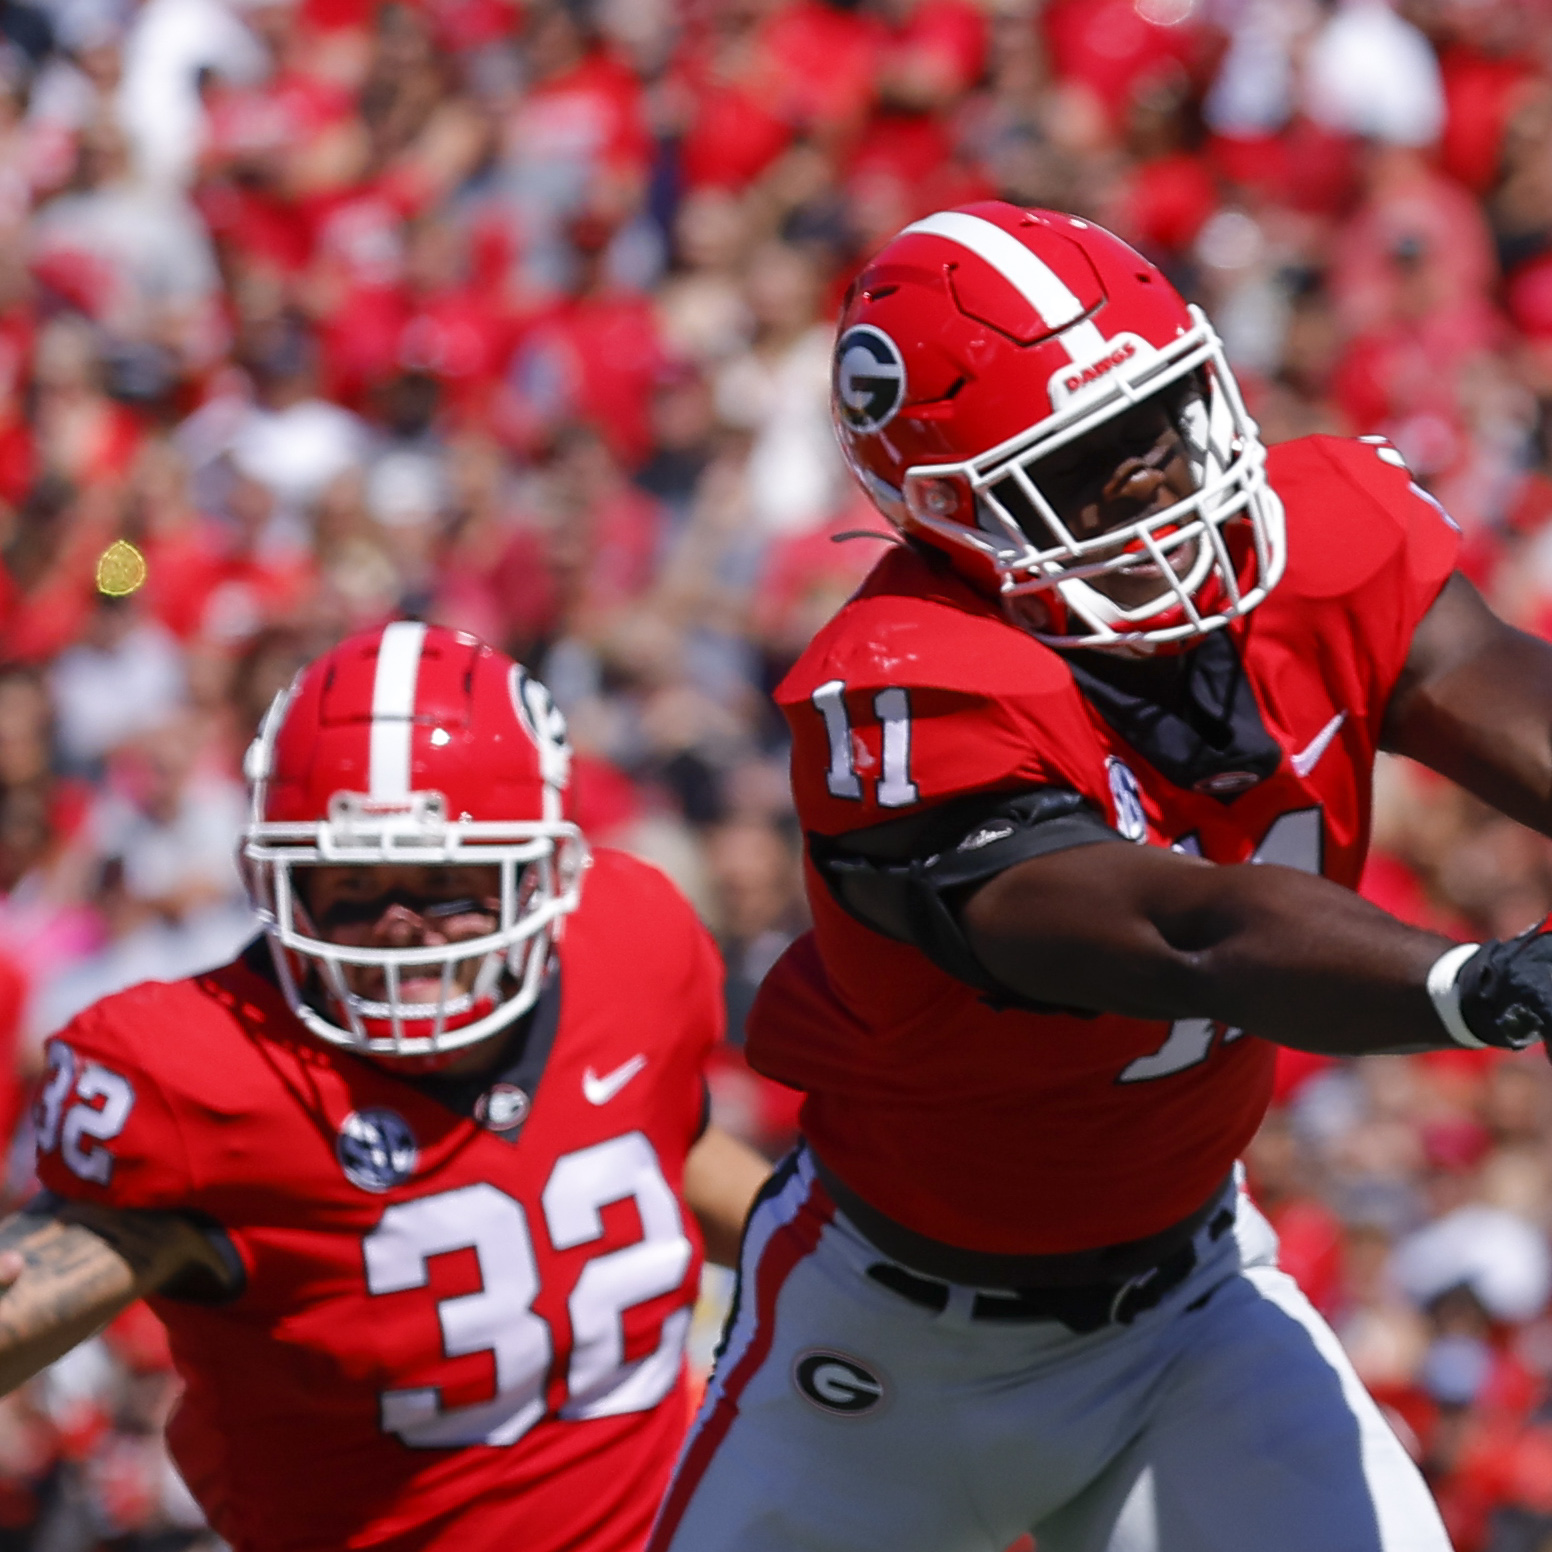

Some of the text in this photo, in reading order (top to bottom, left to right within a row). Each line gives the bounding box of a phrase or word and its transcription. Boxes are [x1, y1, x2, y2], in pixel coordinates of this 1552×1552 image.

[811, 679, 918, 808] 11
[34, 1038, 137, 1188] 32
[363, 1130, 694, 1449] 32
